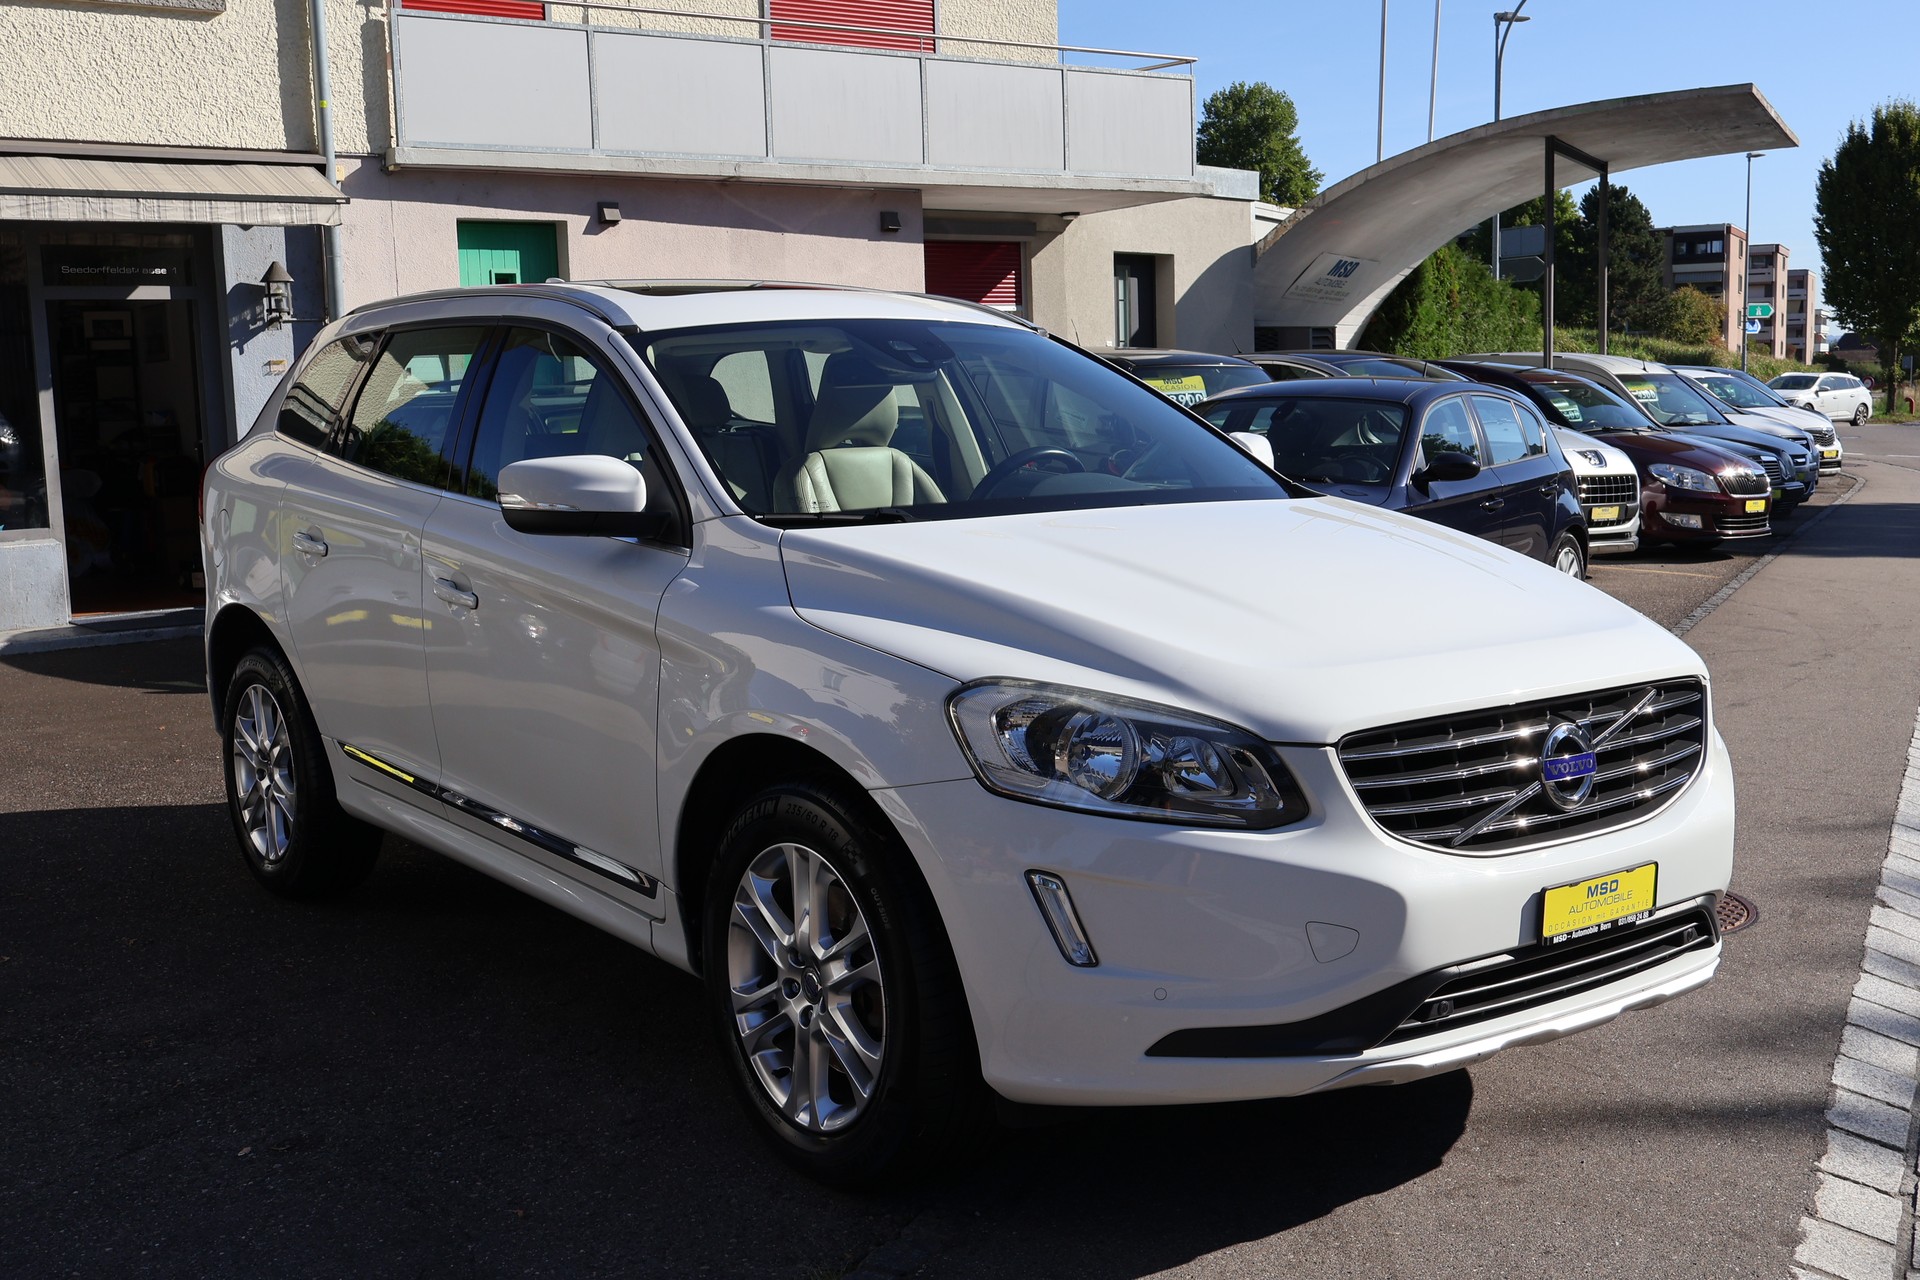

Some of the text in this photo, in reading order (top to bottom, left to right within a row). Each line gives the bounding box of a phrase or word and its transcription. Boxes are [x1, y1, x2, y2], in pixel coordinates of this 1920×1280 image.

[1327, 259, 1360, 278] MSD
[1549, 758, 1593, 776] VOLVO
[719, 799, 840, 859] MICHELIN 235/60 R 18
[1586, 879, 1619, 899] MSD
[870, 887, 892, 929] OUTSIDE
[1568, 890, 1633, 915] AUTOMOBILE
[1548, 915, 1593, 932] OCCASION
[1610, 898, 1649, 917] GARANTIE
[1600, 922, 1611, 931] Bern
